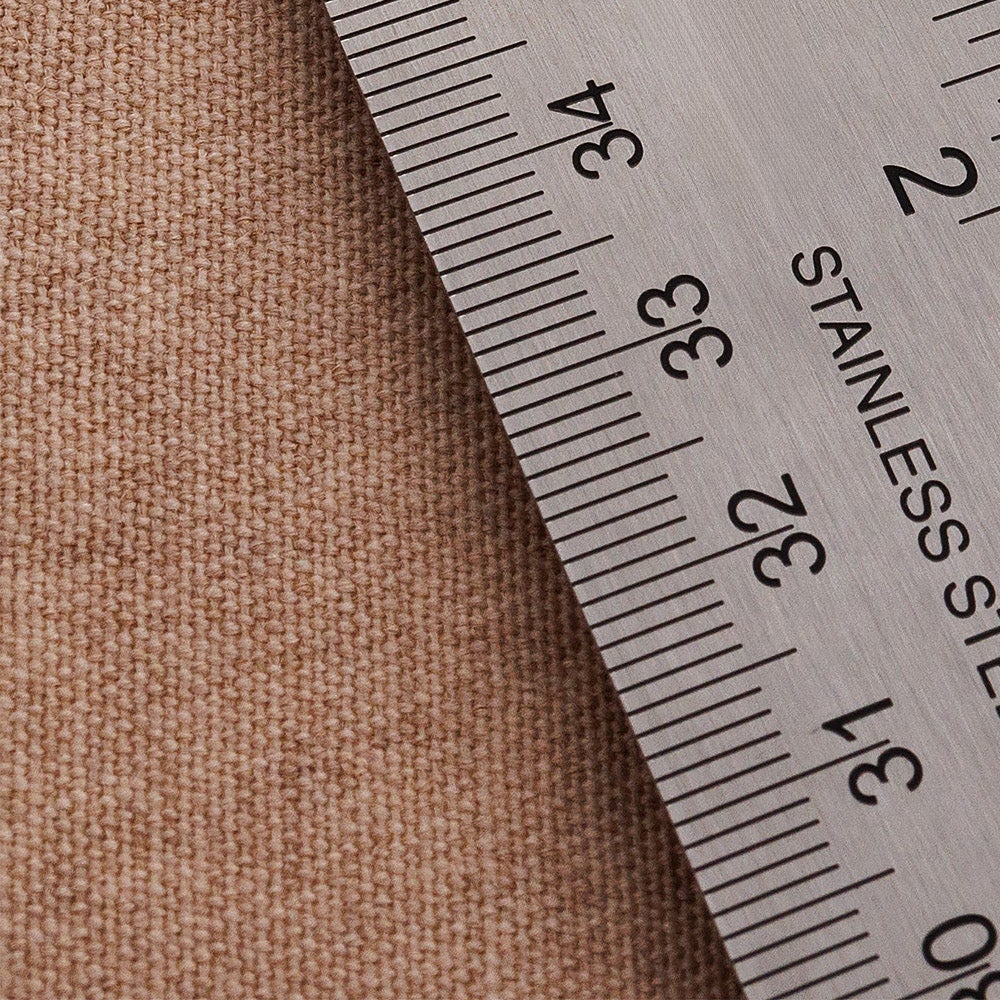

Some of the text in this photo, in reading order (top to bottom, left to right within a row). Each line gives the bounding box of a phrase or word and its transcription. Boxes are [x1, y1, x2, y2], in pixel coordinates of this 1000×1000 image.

[547, 79, 644, 179] 34
[882, 146, 978, 216] 2
[636, 273, 733, 380] 33
[791, 244, 971, 563] STAINLESS
[726, 472, 827, 588] 32
[822, 697, 924, 806] 31
